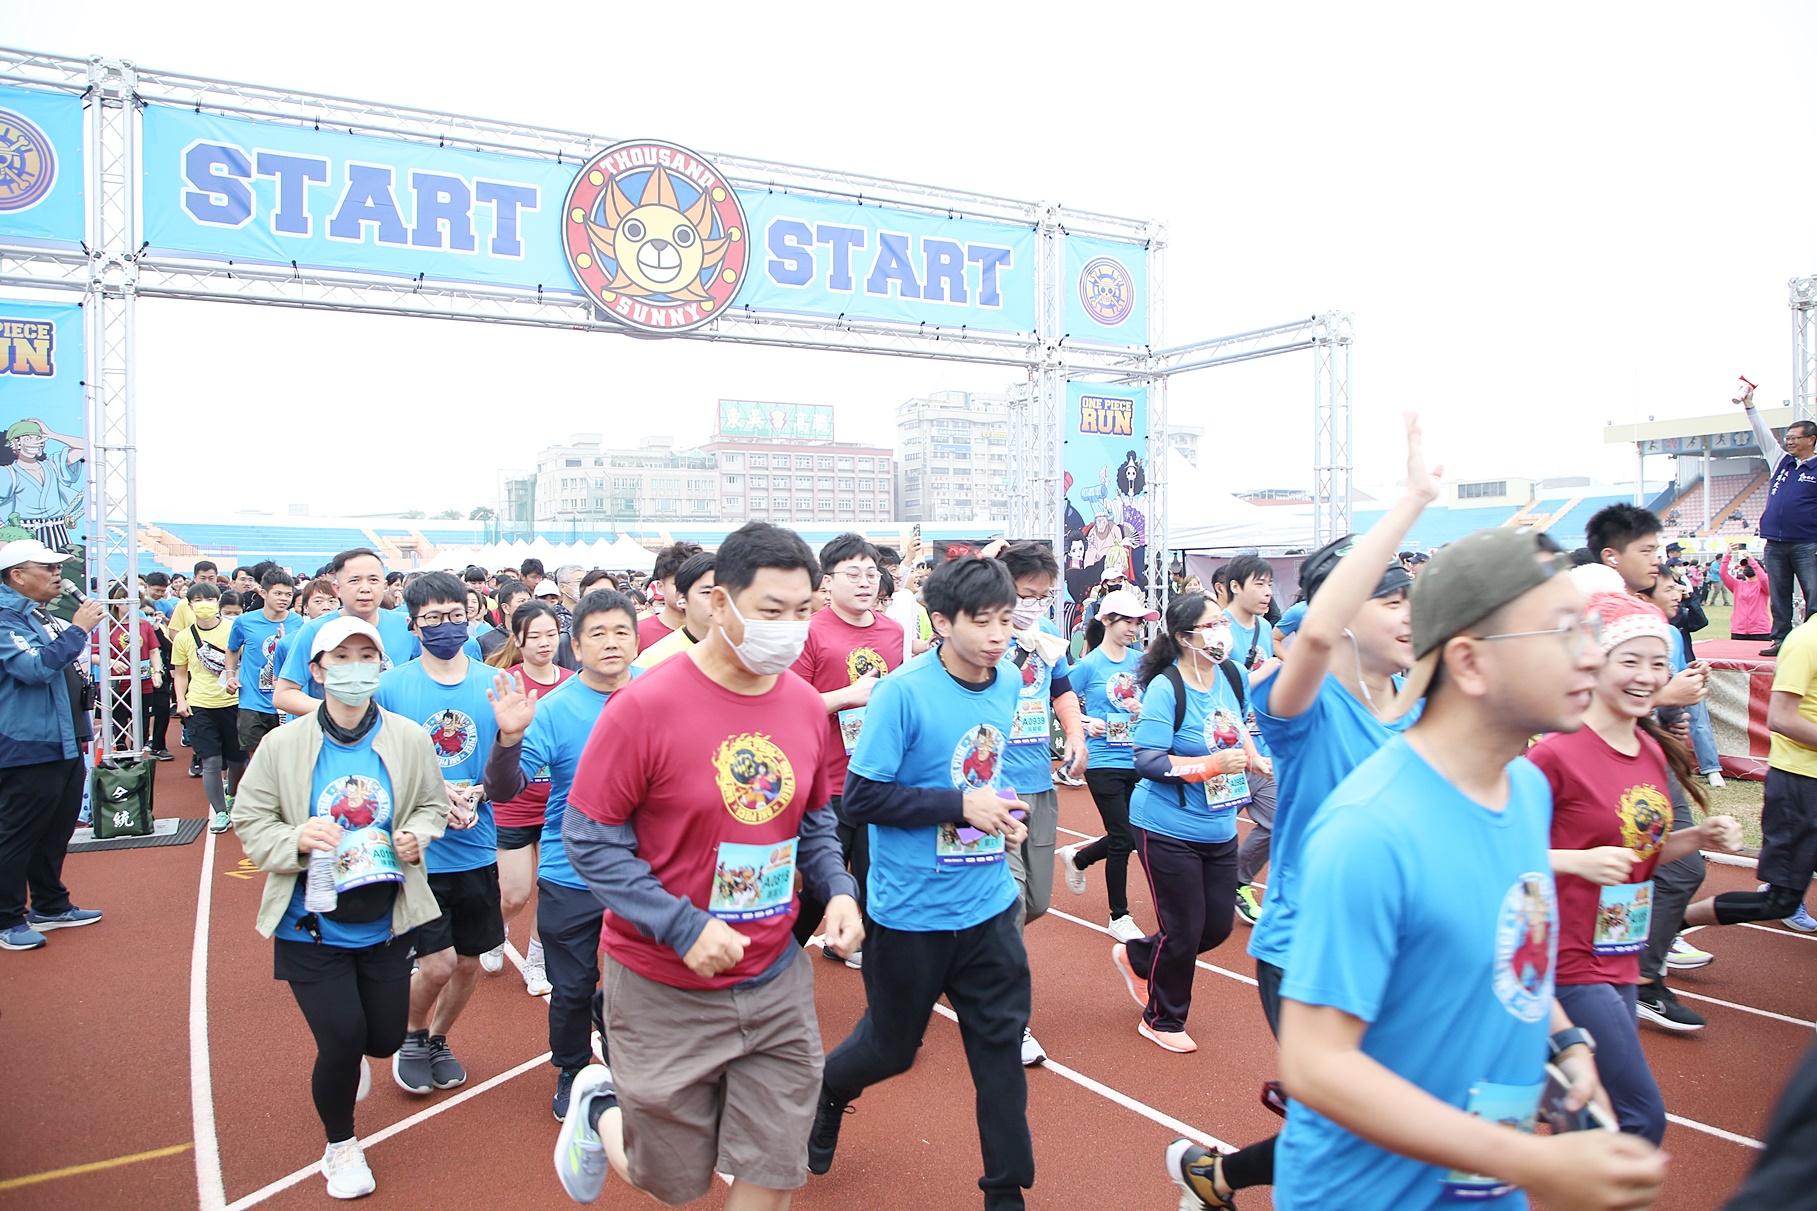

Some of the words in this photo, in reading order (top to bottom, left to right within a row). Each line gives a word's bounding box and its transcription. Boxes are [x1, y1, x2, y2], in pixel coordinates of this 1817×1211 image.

[599, 147, 716, 187] THOUSAND
[184, 141, 539, 258] START
[767, 218, 1011, 307] START
[616, 296, 700, 327] SUNNY
[1081, 408, 1132, 434] RUN
[1082, 398, 1102, 409] ONE
[1105, 399, 1132, 411] PIECE
